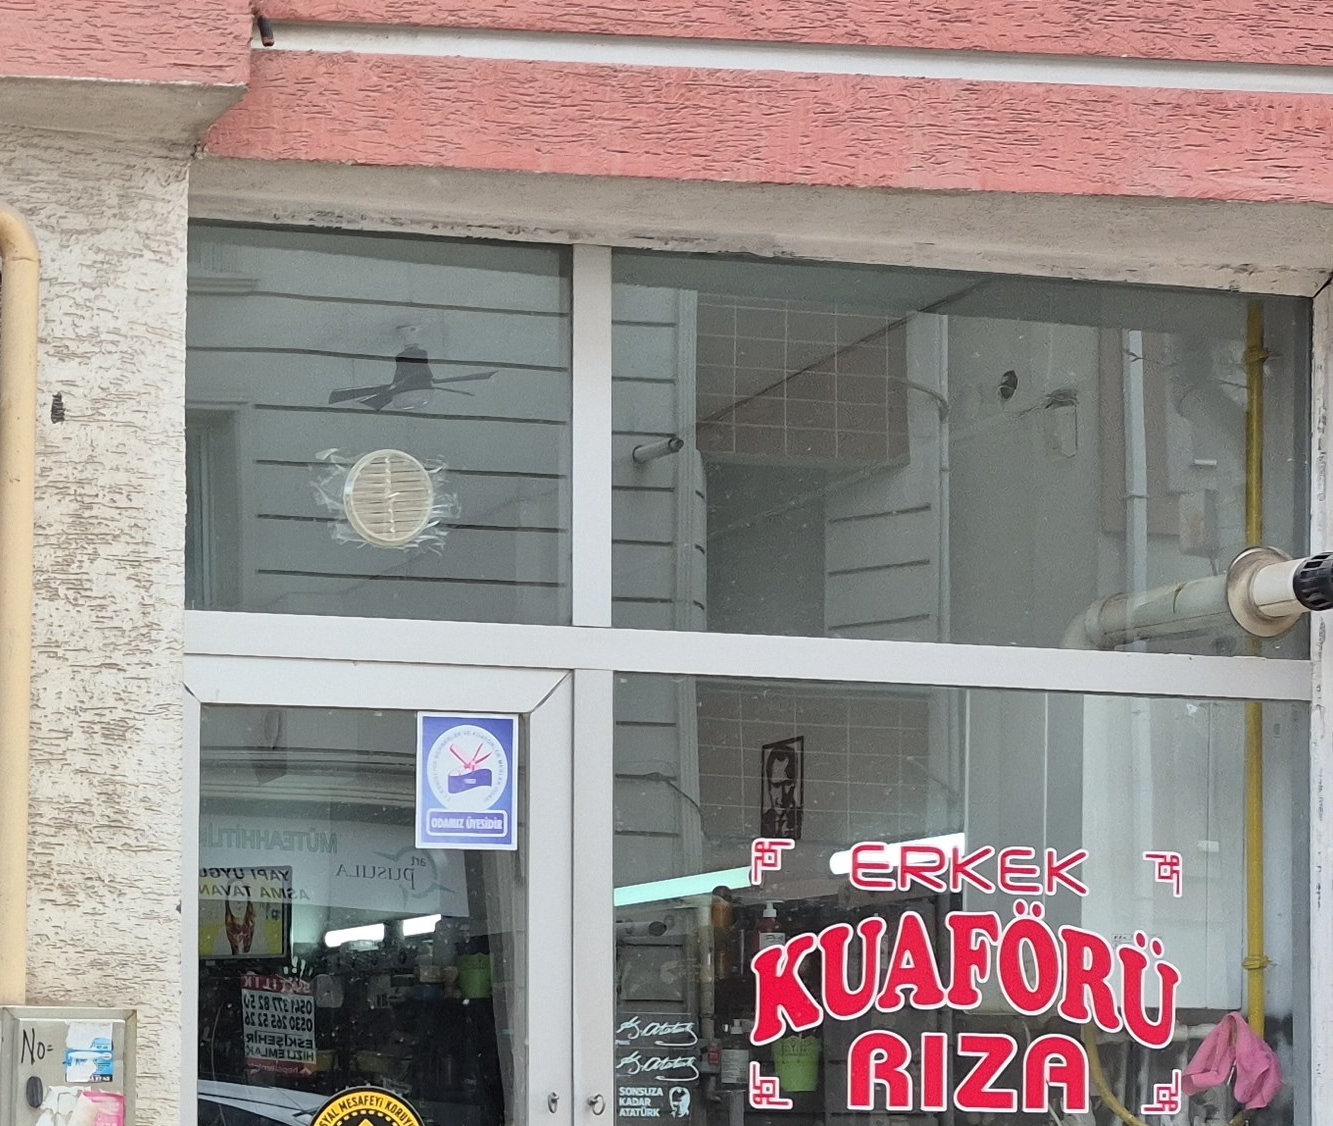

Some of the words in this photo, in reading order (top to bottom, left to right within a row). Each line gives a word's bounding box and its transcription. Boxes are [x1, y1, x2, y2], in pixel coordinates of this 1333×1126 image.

[849, 841, 1089, 896] ERKEK
[750, 899, 1181, 1049] KUAFÖRÜ
[847, 1029, 1090, 1114] RIZA
[619, 1086, 663, 1096] SONSUZA
[338, 1095, 384, 1112] MESAFEYİ
[619, 1097, 651, 1106] KADAR
[619, 1107, 660, 1117] ATATÜRK
